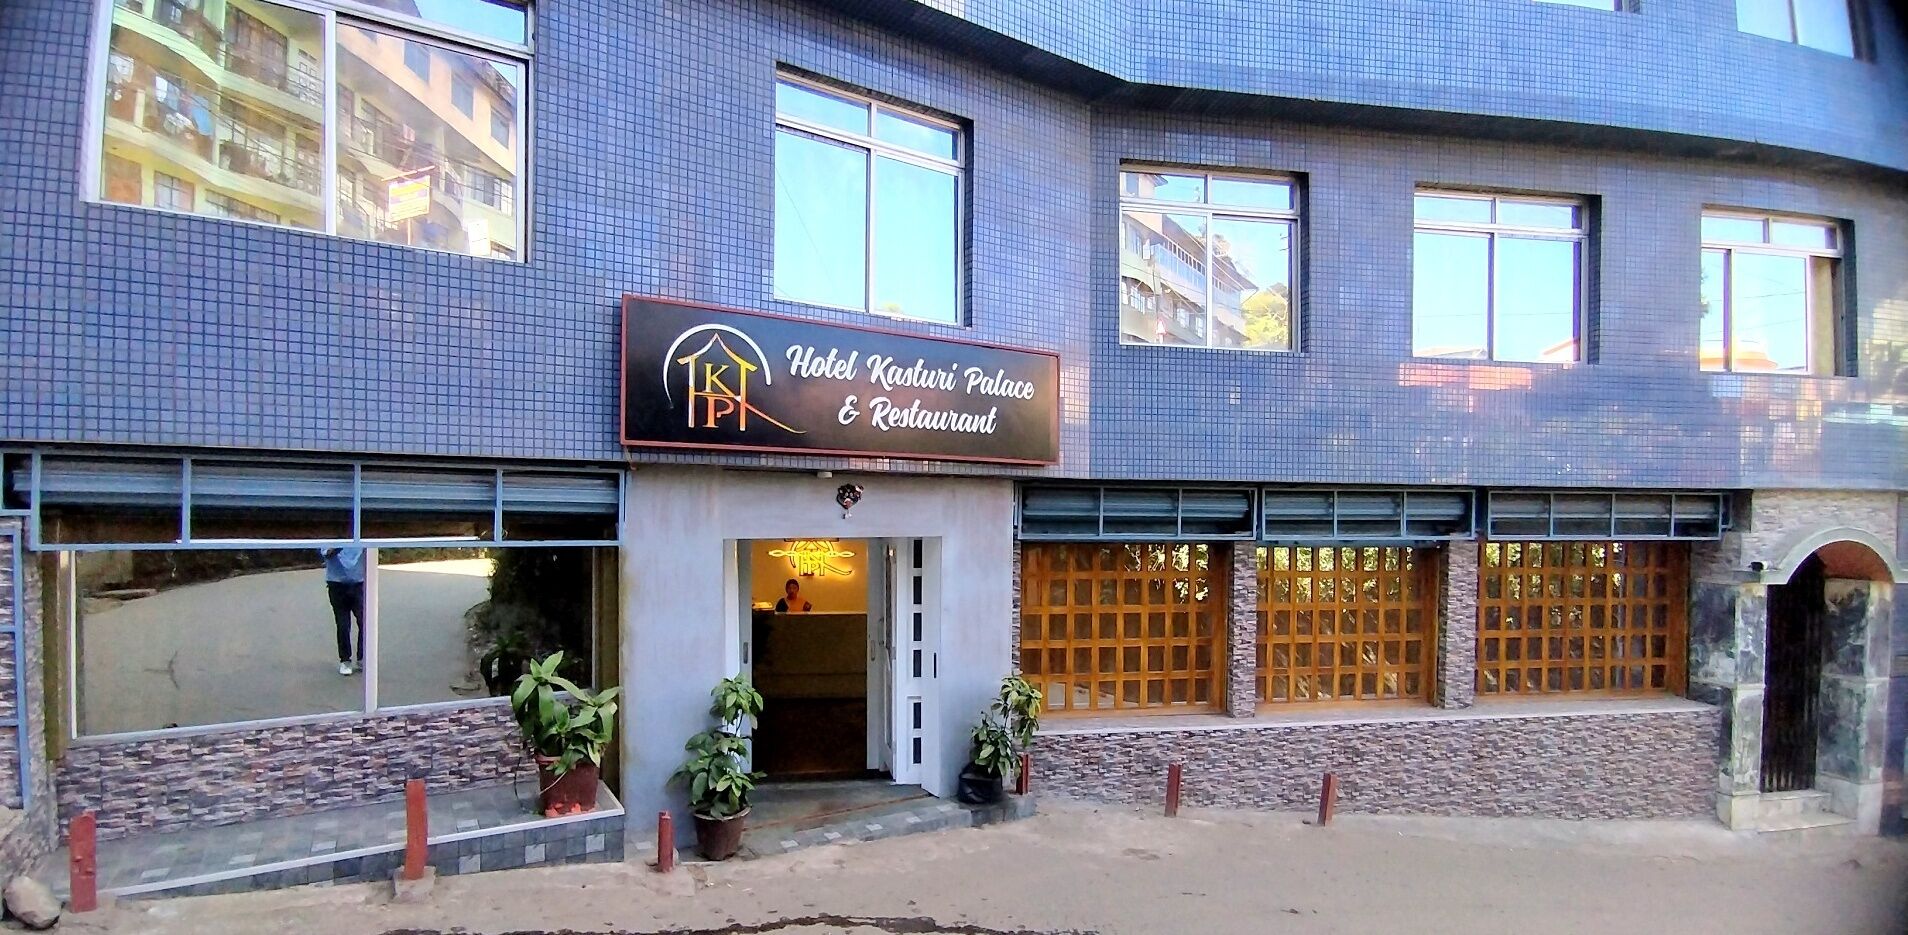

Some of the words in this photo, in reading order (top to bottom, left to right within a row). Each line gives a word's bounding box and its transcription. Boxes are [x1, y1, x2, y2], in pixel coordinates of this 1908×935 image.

[785, 344, 858, 379] Hotel
[867, 353, 956, 391] Kasturi
[964, 367, 1034, 400] Palace
[838, 395, 860, 425] &
[870, 396, 997, 434] Restaurant
